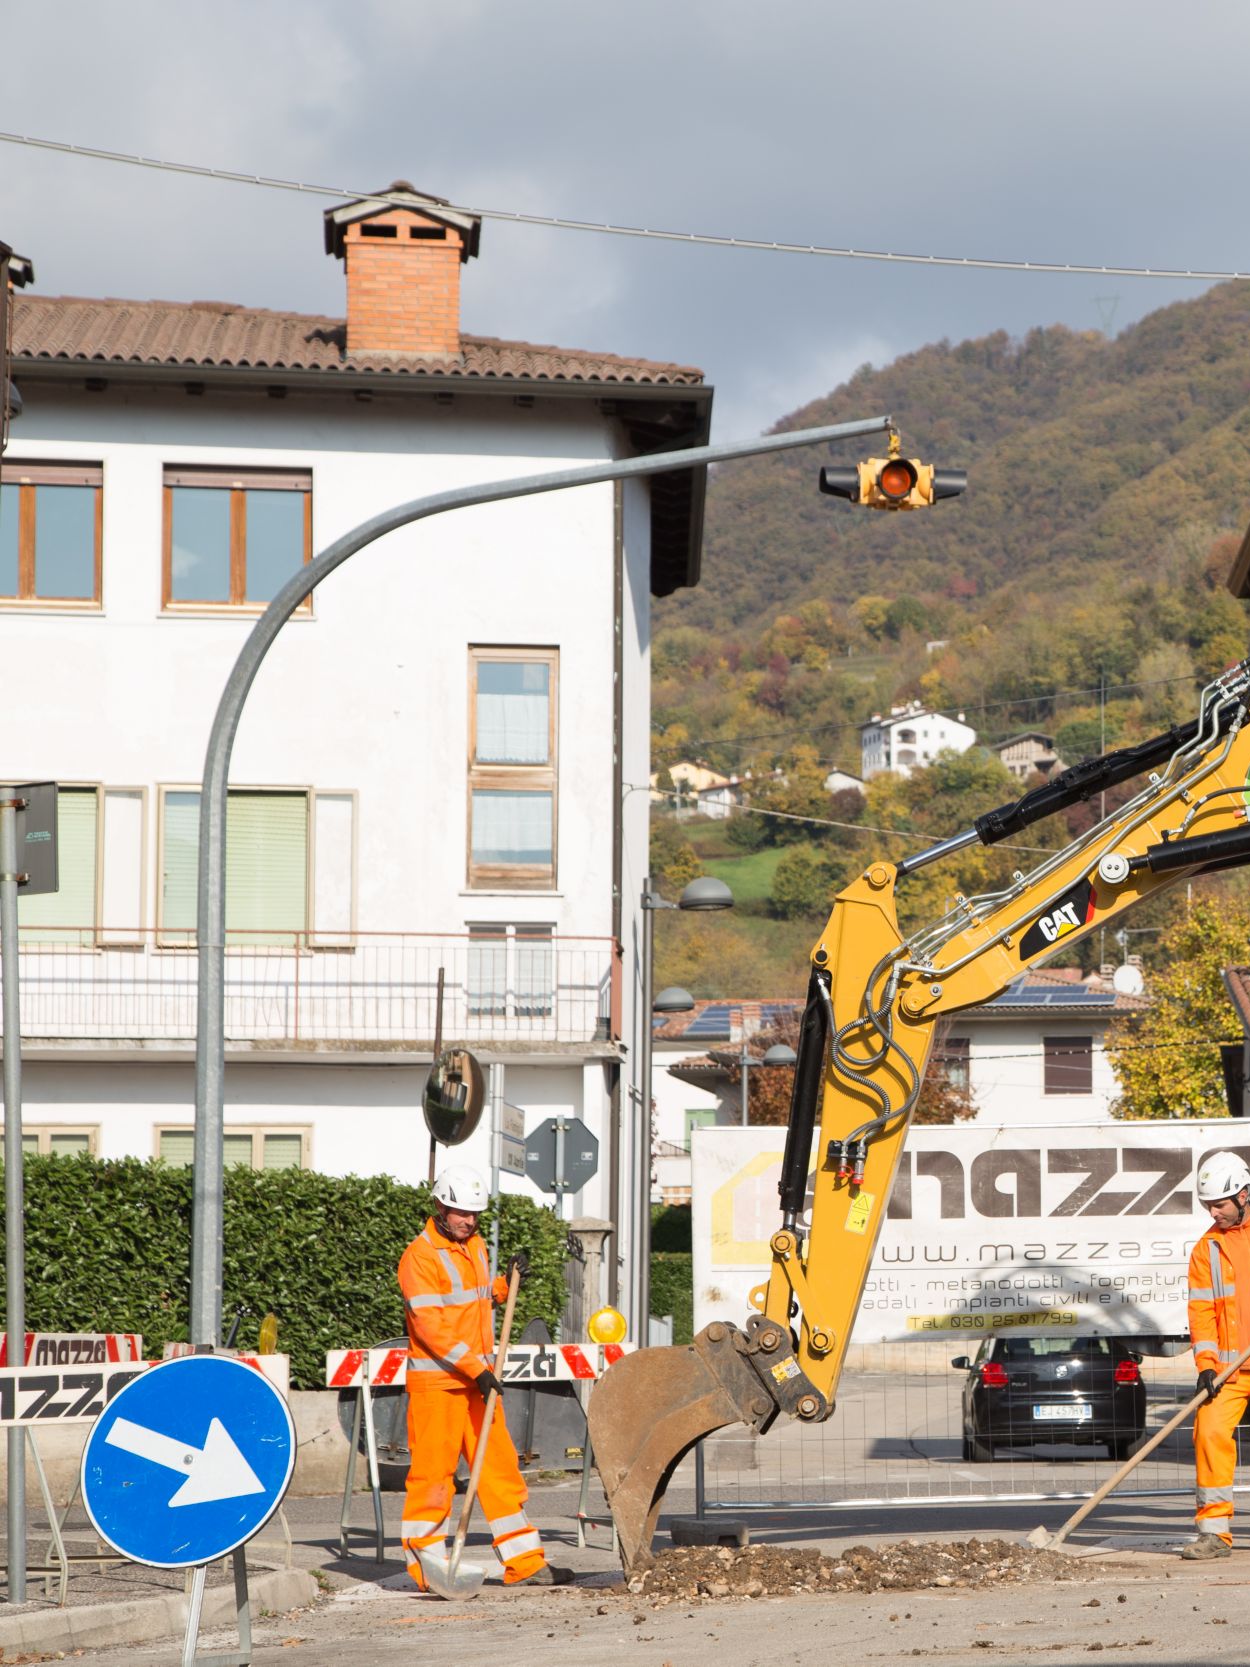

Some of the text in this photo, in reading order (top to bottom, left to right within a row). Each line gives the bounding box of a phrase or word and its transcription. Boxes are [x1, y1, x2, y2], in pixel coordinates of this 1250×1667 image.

[1038, 901, 1081, 942] CAT
[926, 1273, 1064, 1292] metanodotti
[943, 1293, 1029, 1312] impianti
[1039, 1290, 1090, 1307] civili
[1099, 1293, 1111, 1305] e
[909, 1312, 1074, 1330] Tel. 030 25.01.799
[502, 1353, 557, 1378] za
